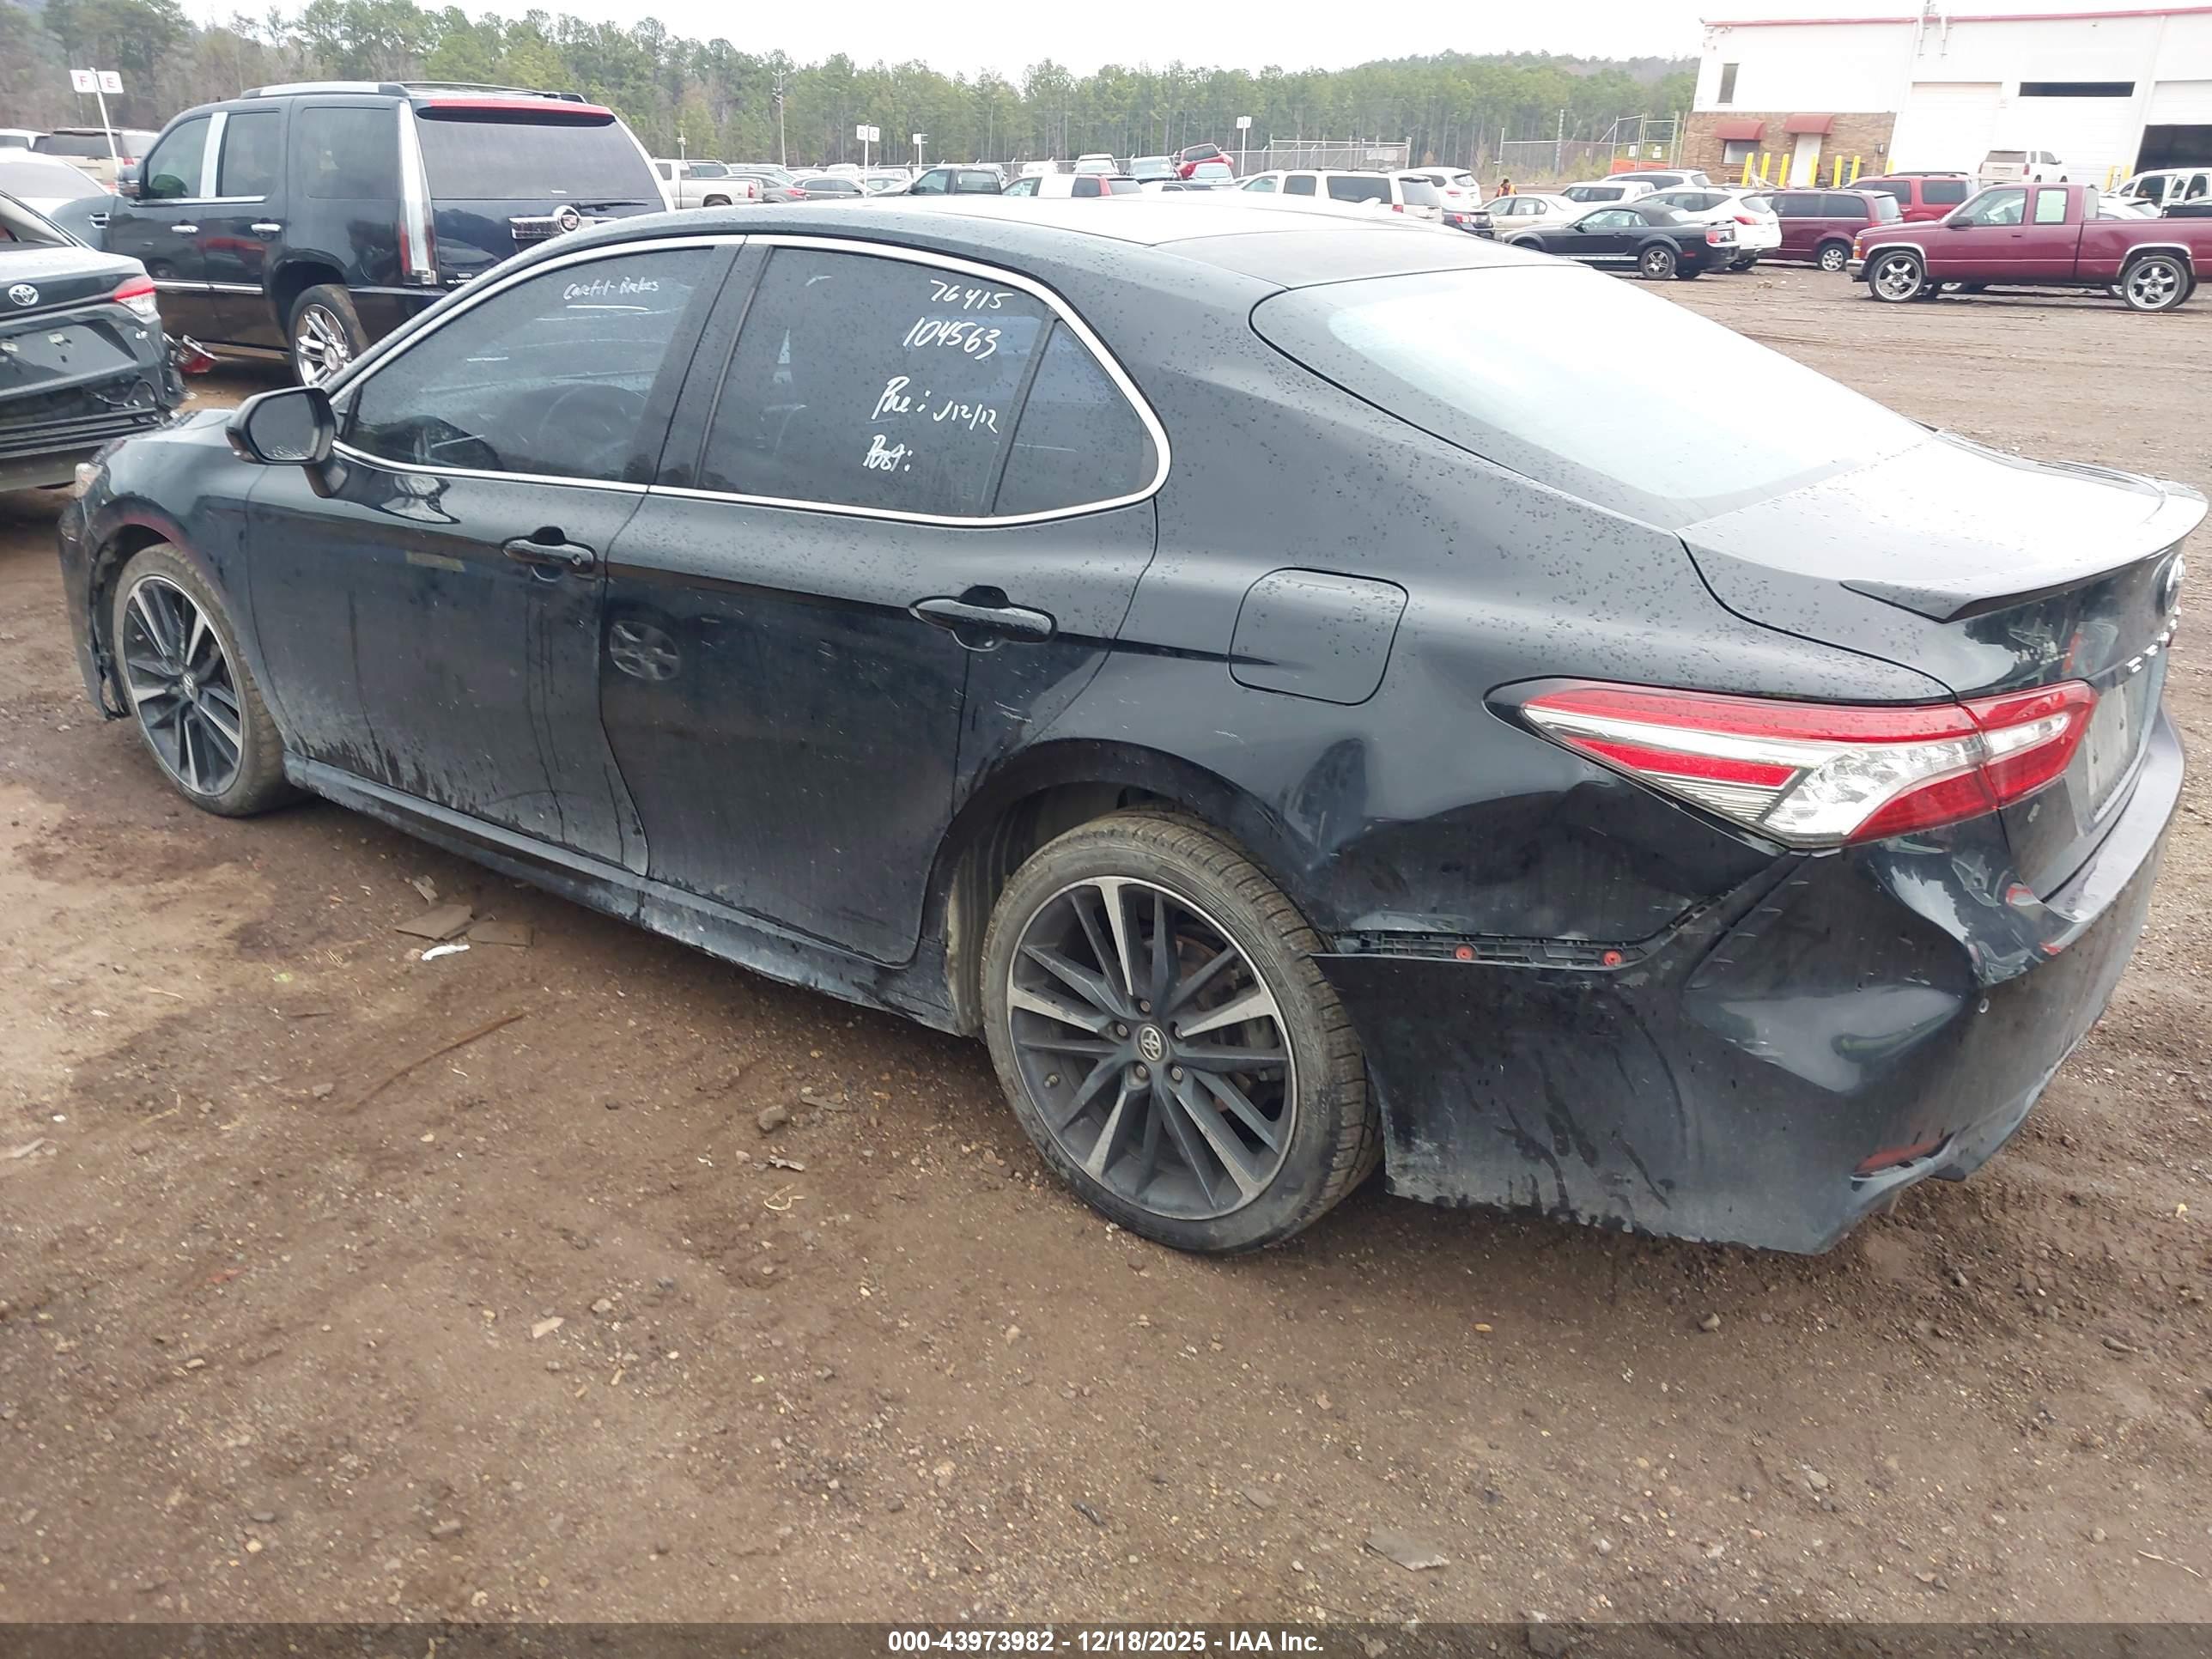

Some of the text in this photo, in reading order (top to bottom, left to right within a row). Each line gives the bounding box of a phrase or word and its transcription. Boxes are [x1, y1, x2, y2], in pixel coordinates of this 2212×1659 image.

[79, 76, 88, 88] F
[105, 76, 118, 88] E
[930, 279, 1015, 310] 76415
[902, 316, 1002, 360] 104563
